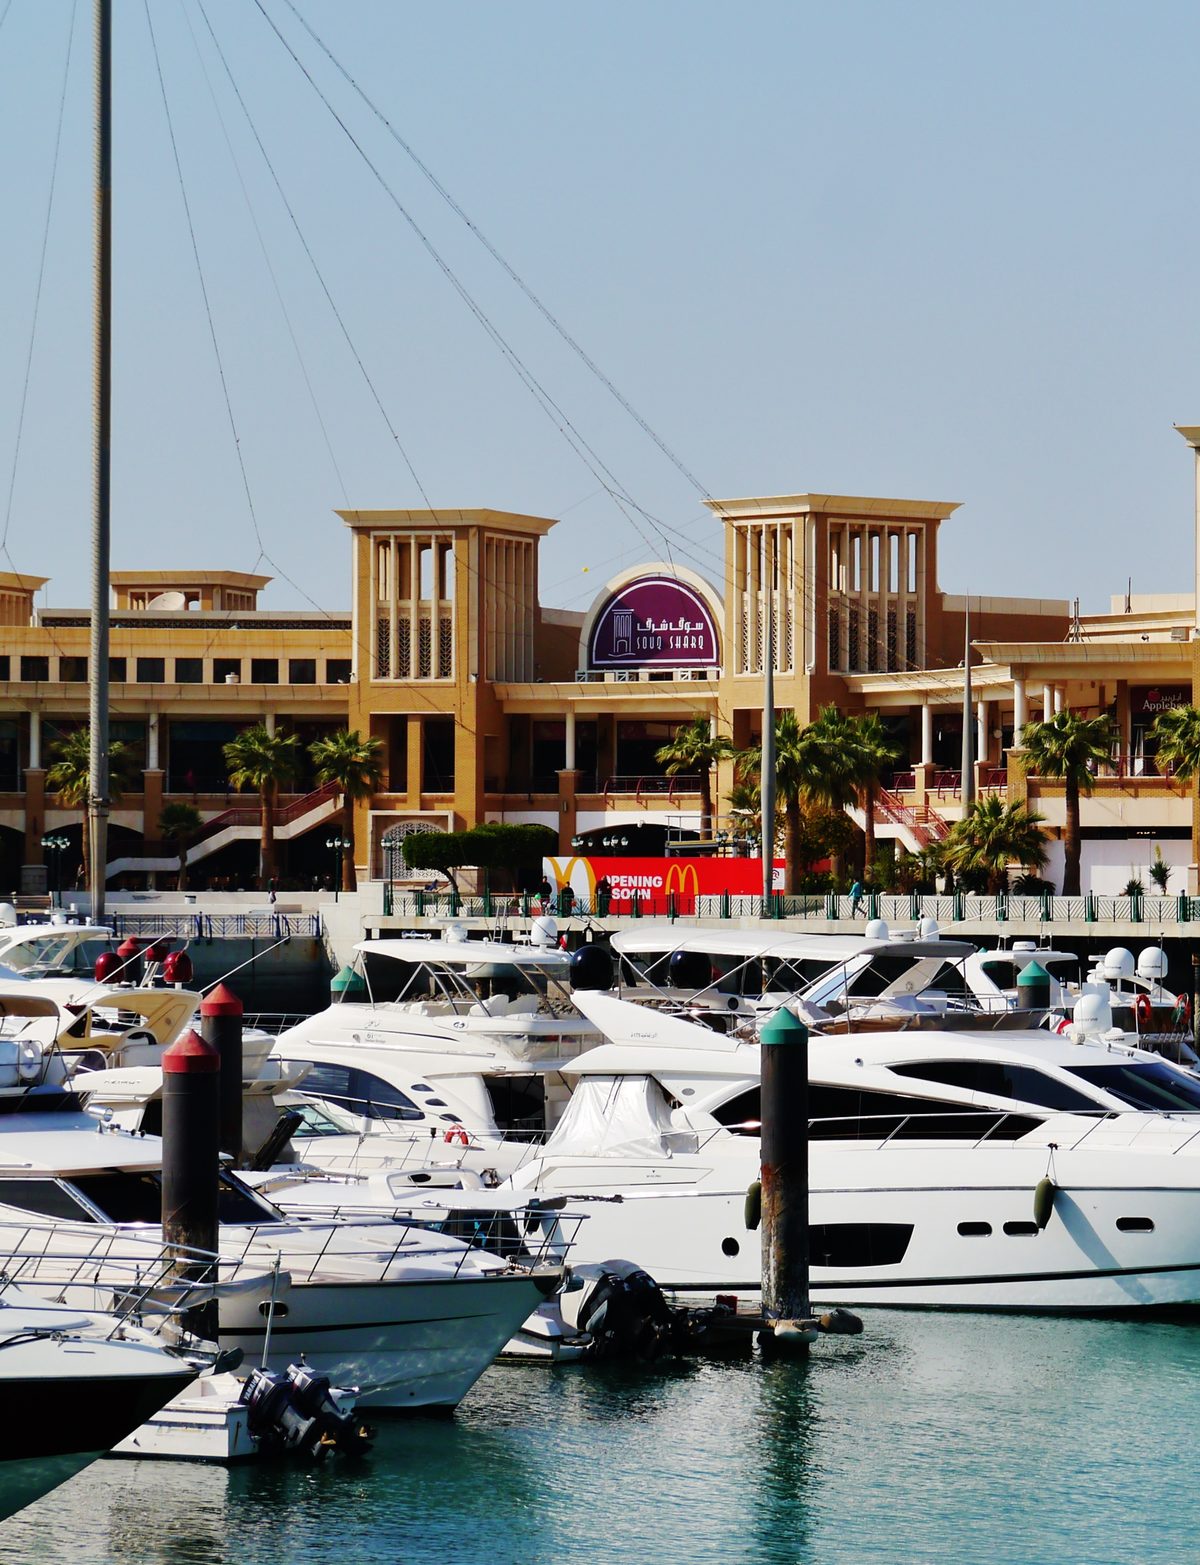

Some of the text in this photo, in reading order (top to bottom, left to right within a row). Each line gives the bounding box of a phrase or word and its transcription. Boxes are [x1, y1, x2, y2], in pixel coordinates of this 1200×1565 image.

[637, 617, 704, 634] سوق شرق
[636, 635, 704, 650] SOUQ SHARQ
